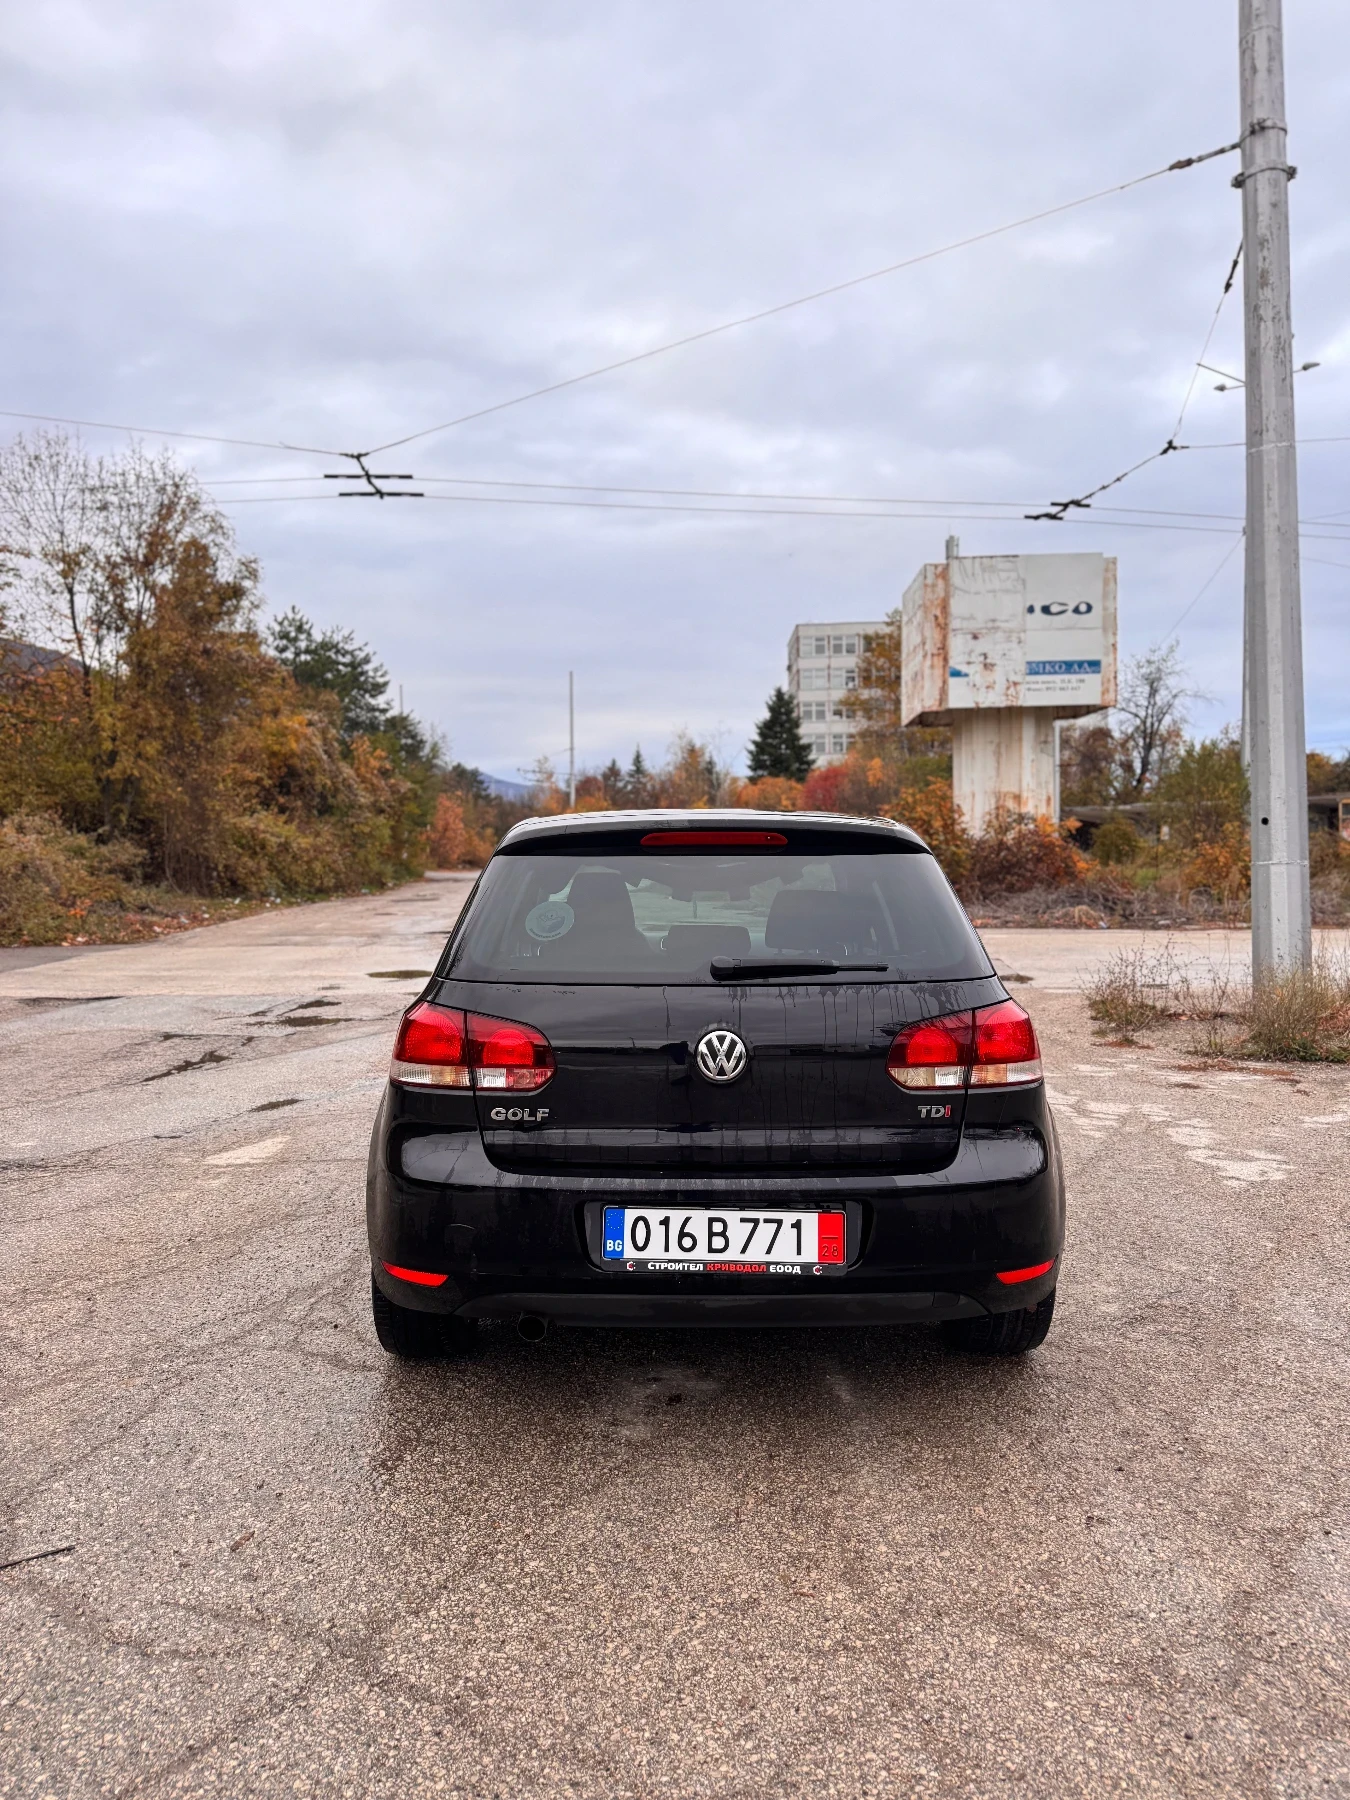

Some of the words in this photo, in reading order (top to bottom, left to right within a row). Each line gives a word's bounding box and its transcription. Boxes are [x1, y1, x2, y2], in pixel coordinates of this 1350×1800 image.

[490, 1107, 550, 1122] GOLF
[606, 1240, 623, 1252] BG
[821, 1243, 839, 1258] 28
[647, 1261, 704, 1272] СТРОИТЕЛ
[706, 1263, 767, 1274] КРИВОДОЛ
[769, 1264, 802, 1275] ЕООД
